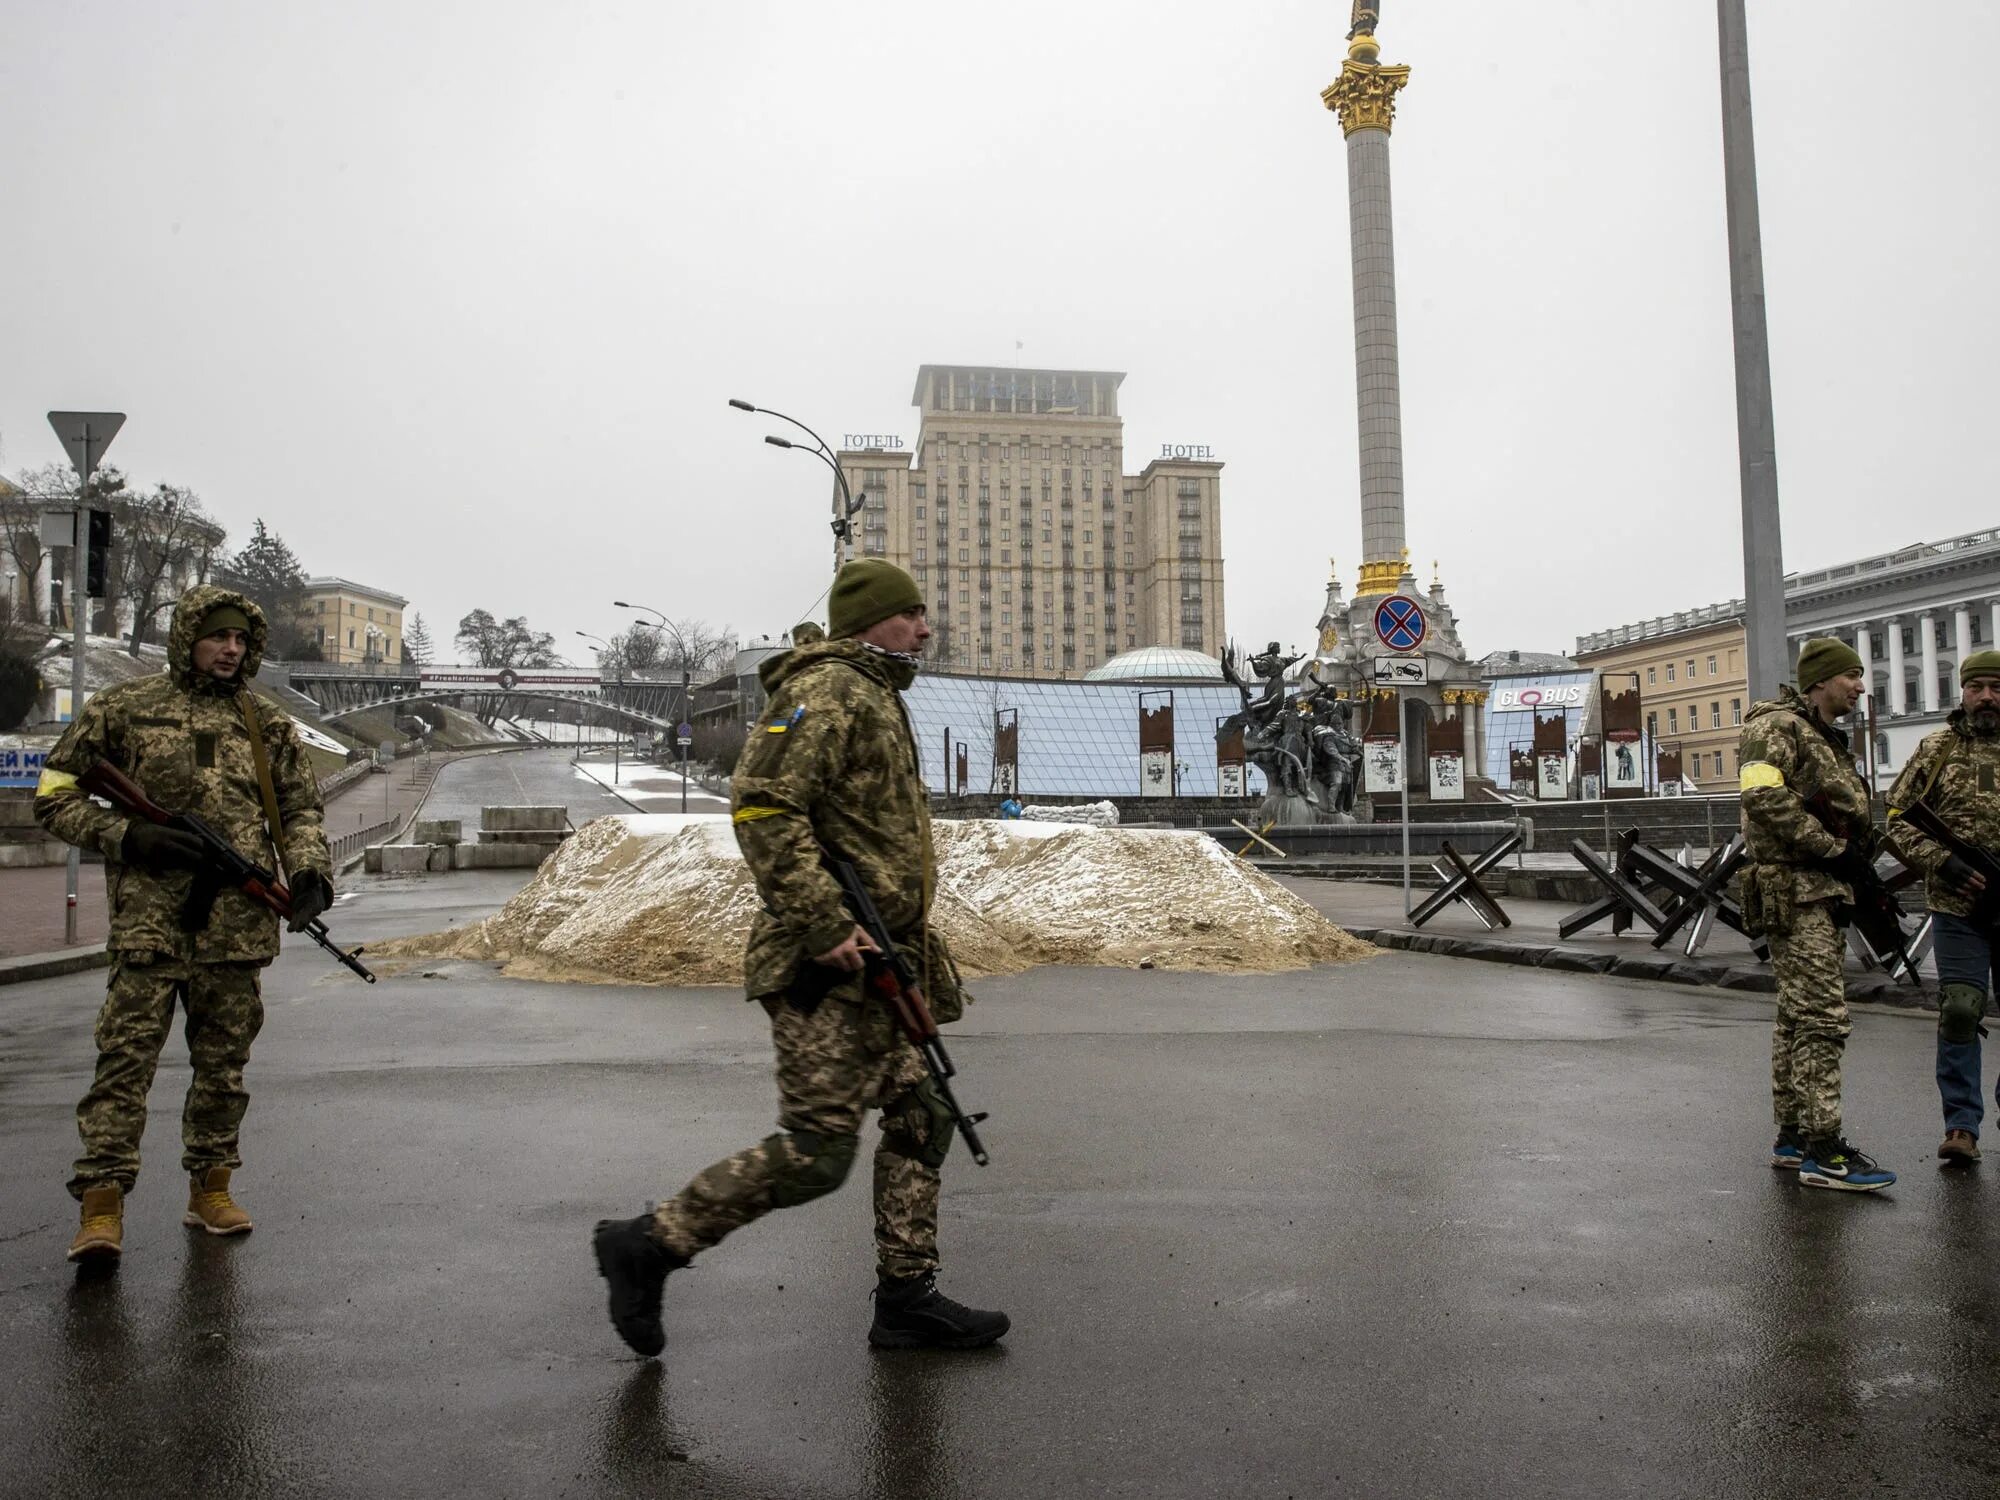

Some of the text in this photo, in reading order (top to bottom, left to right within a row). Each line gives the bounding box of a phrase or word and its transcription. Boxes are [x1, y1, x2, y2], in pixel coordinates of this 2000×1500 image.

[843, 434, 904, 448] ГОТЕЛЬ
[1161, 444, 1215, 458] HOTEL
[1500, 686, 1581, 706] GLOBUS
